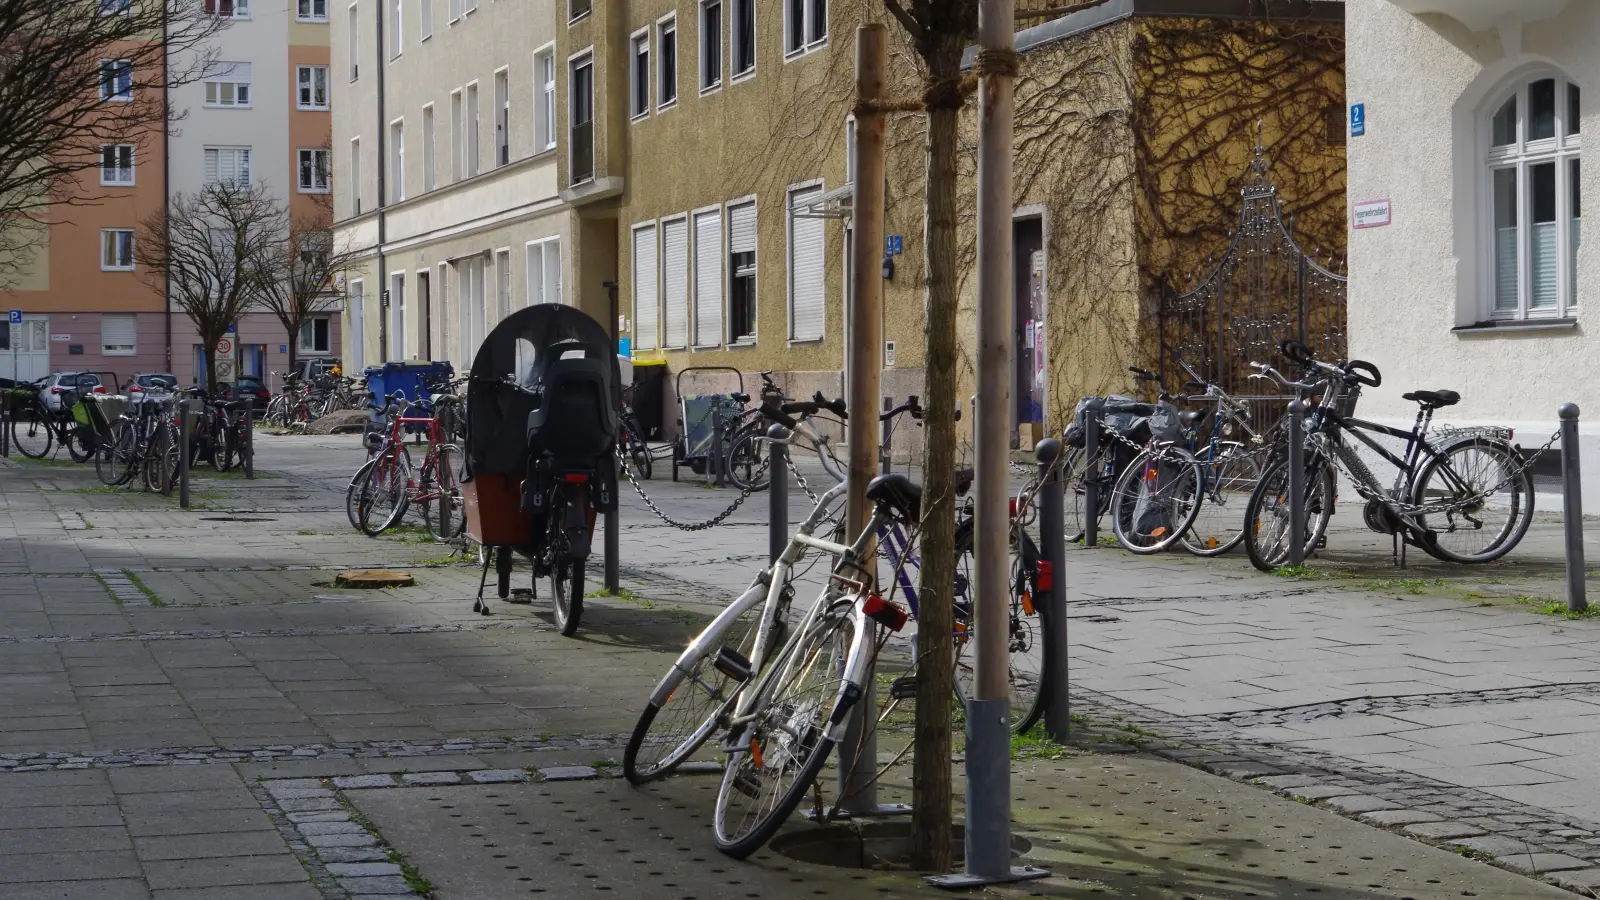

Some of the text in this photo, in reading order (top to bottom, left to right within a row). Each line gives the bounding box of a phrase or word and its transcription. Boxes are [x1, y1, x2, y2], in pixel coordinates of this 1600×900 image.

[1353, 106, 1359, 122] 2
[11, 311, 18, 322] P
[219, 342, 229, 350] 30
